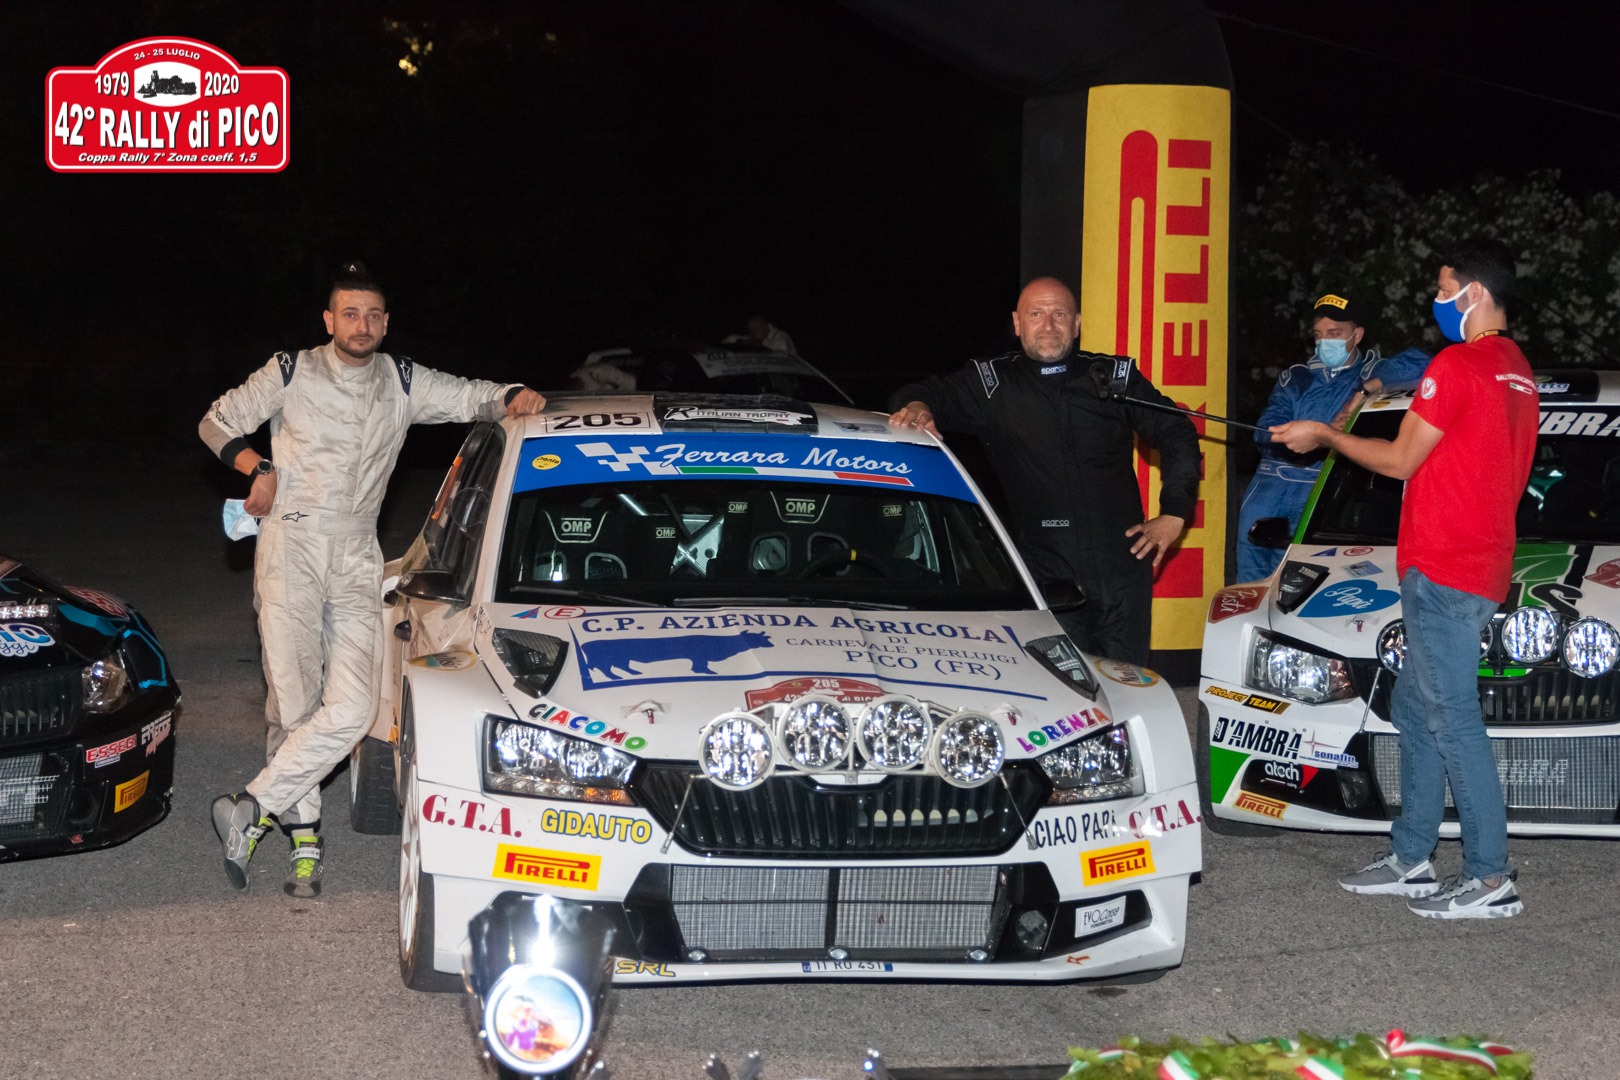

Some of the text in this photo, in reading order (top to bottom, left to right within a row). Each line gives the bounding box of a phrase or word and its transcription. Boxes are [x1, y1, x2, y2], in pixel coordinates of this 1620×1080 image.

[1116, 129, 1212, 598] PELLI
[553, 413, 642, 430] 205
[696, 409, 741, 418] ITALIAN
[745, 410, 790, 419] TROPHY
[1538, 411, 1620, 437] BRA
[655, 443, 912, 475] Ferrara Motors
[728, 503, 748, 512] OMP
[785, 502, 816, 514] OMP
[561, 519, 592, 534] OMP
[655, 528, 676, 537] OMP
[582, 613, 1007, 644] C.P. AZIENDA AGRICOLA
[888, 636, 911, 644] DI
[786, 638, 1019, 665] CARNEVALE PIERLUIGI
[845, 650, 1002, 681] PICO (FR)
[812, 679, 840, 688] 205
[1205, 685, 1277, 710] PROJECT TEAM
[528, 703, 646, 751] GIACOMO
[1016, 707, 1112, 754] LORENZA
[1212, 716, 1302, 760] D'AMBRA
[422, 794, 522, 838] G.T.A.
[1235, 792, 1286, 818] PIRELLI
[541, 809, 652, 844] GIDAUTO
[1034, 815, 1077, 848] CIAO
[504, 852, 591, 883] PIRELLI
[1088, 848, 1147, 879] PIRELLI
[615, 960, 676, 977] SRL
